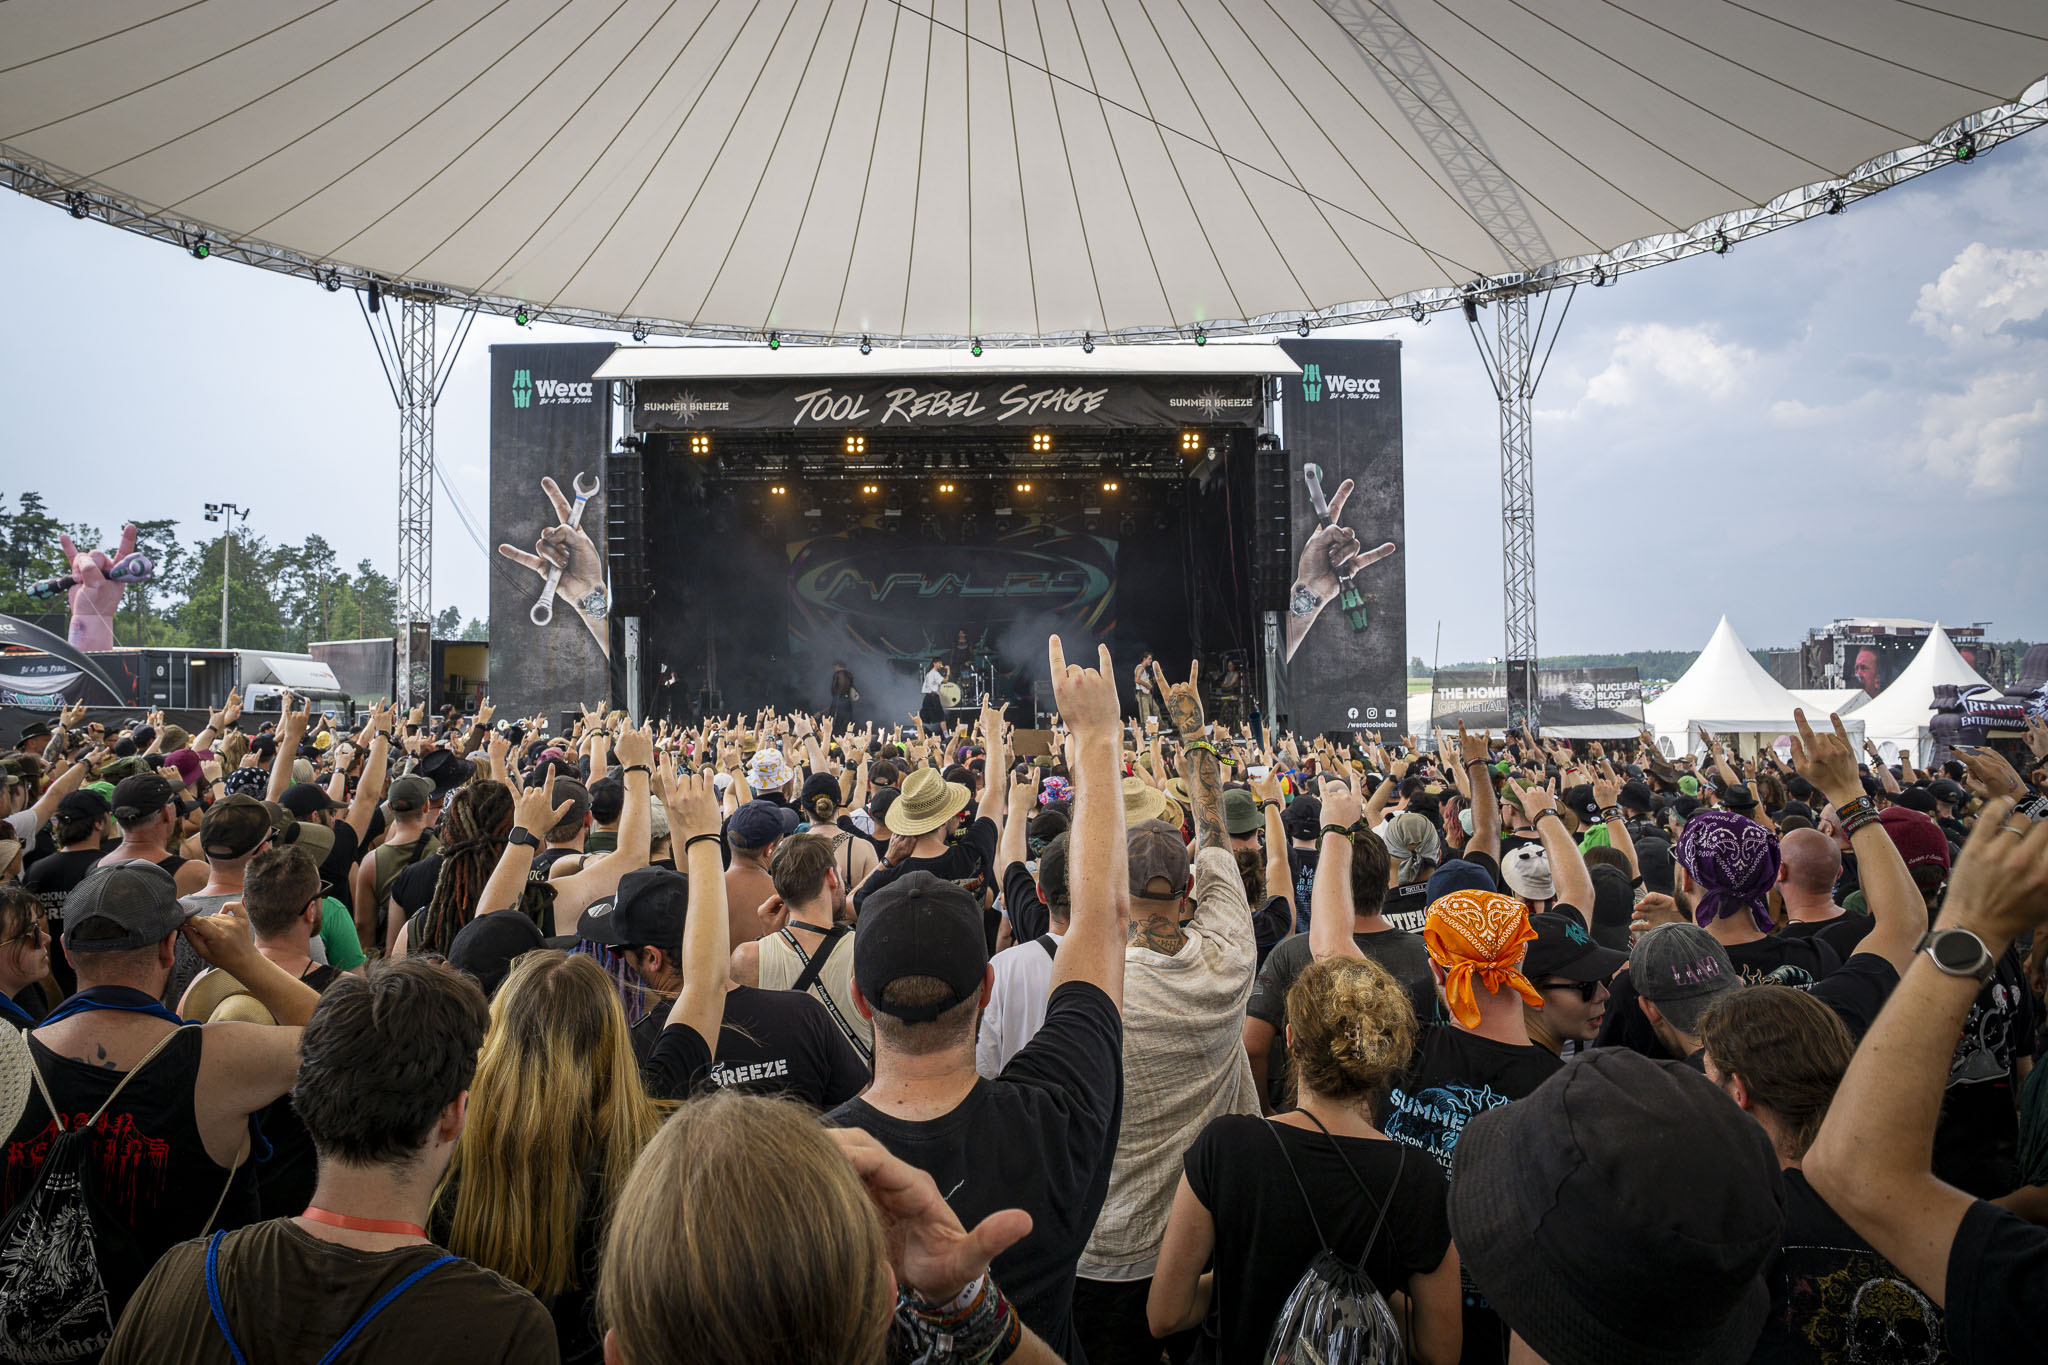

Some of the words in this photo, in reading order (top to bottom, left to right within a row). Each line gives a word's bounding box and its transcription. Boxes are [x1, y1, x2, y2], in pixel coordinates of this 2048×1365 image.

[535, 380, 593, 398] Wera
[1325, 375, 1380, 393] Wera
[643, 402, 687, 411] SUMMER
[689, 402, 730, 411] BREEZE
[794, 388, 870, 425] TOOL
[881, 387, 986, 424] REBEL
[997, 384, 1109, 422] STAGE
[1169, 398, 1212, 407] SUMMER
[1214, 398, 1254, 407] BREEZE
[1438, 687, 1464, 700] THE
[1466, 686, 1508, 699] HOME
[1596, 682, 1640, 692] NUCLEAR
[1596, 691, 1626, 700] BLAST
[1438, 702, 1457, 713] OF
[1460, 700, 1505, 713] METAL
[1597, 699, 1641, 709] RECORDS
[1969, 700, 2025, 718] REAPER
[1381, 909, 1425, 931] NTIFA
[1671, 955, 1720, 986] LAND
[1390, 1088, 1466, 1132] SUMME
[1427, 1145, 1451, 1160] AMA
